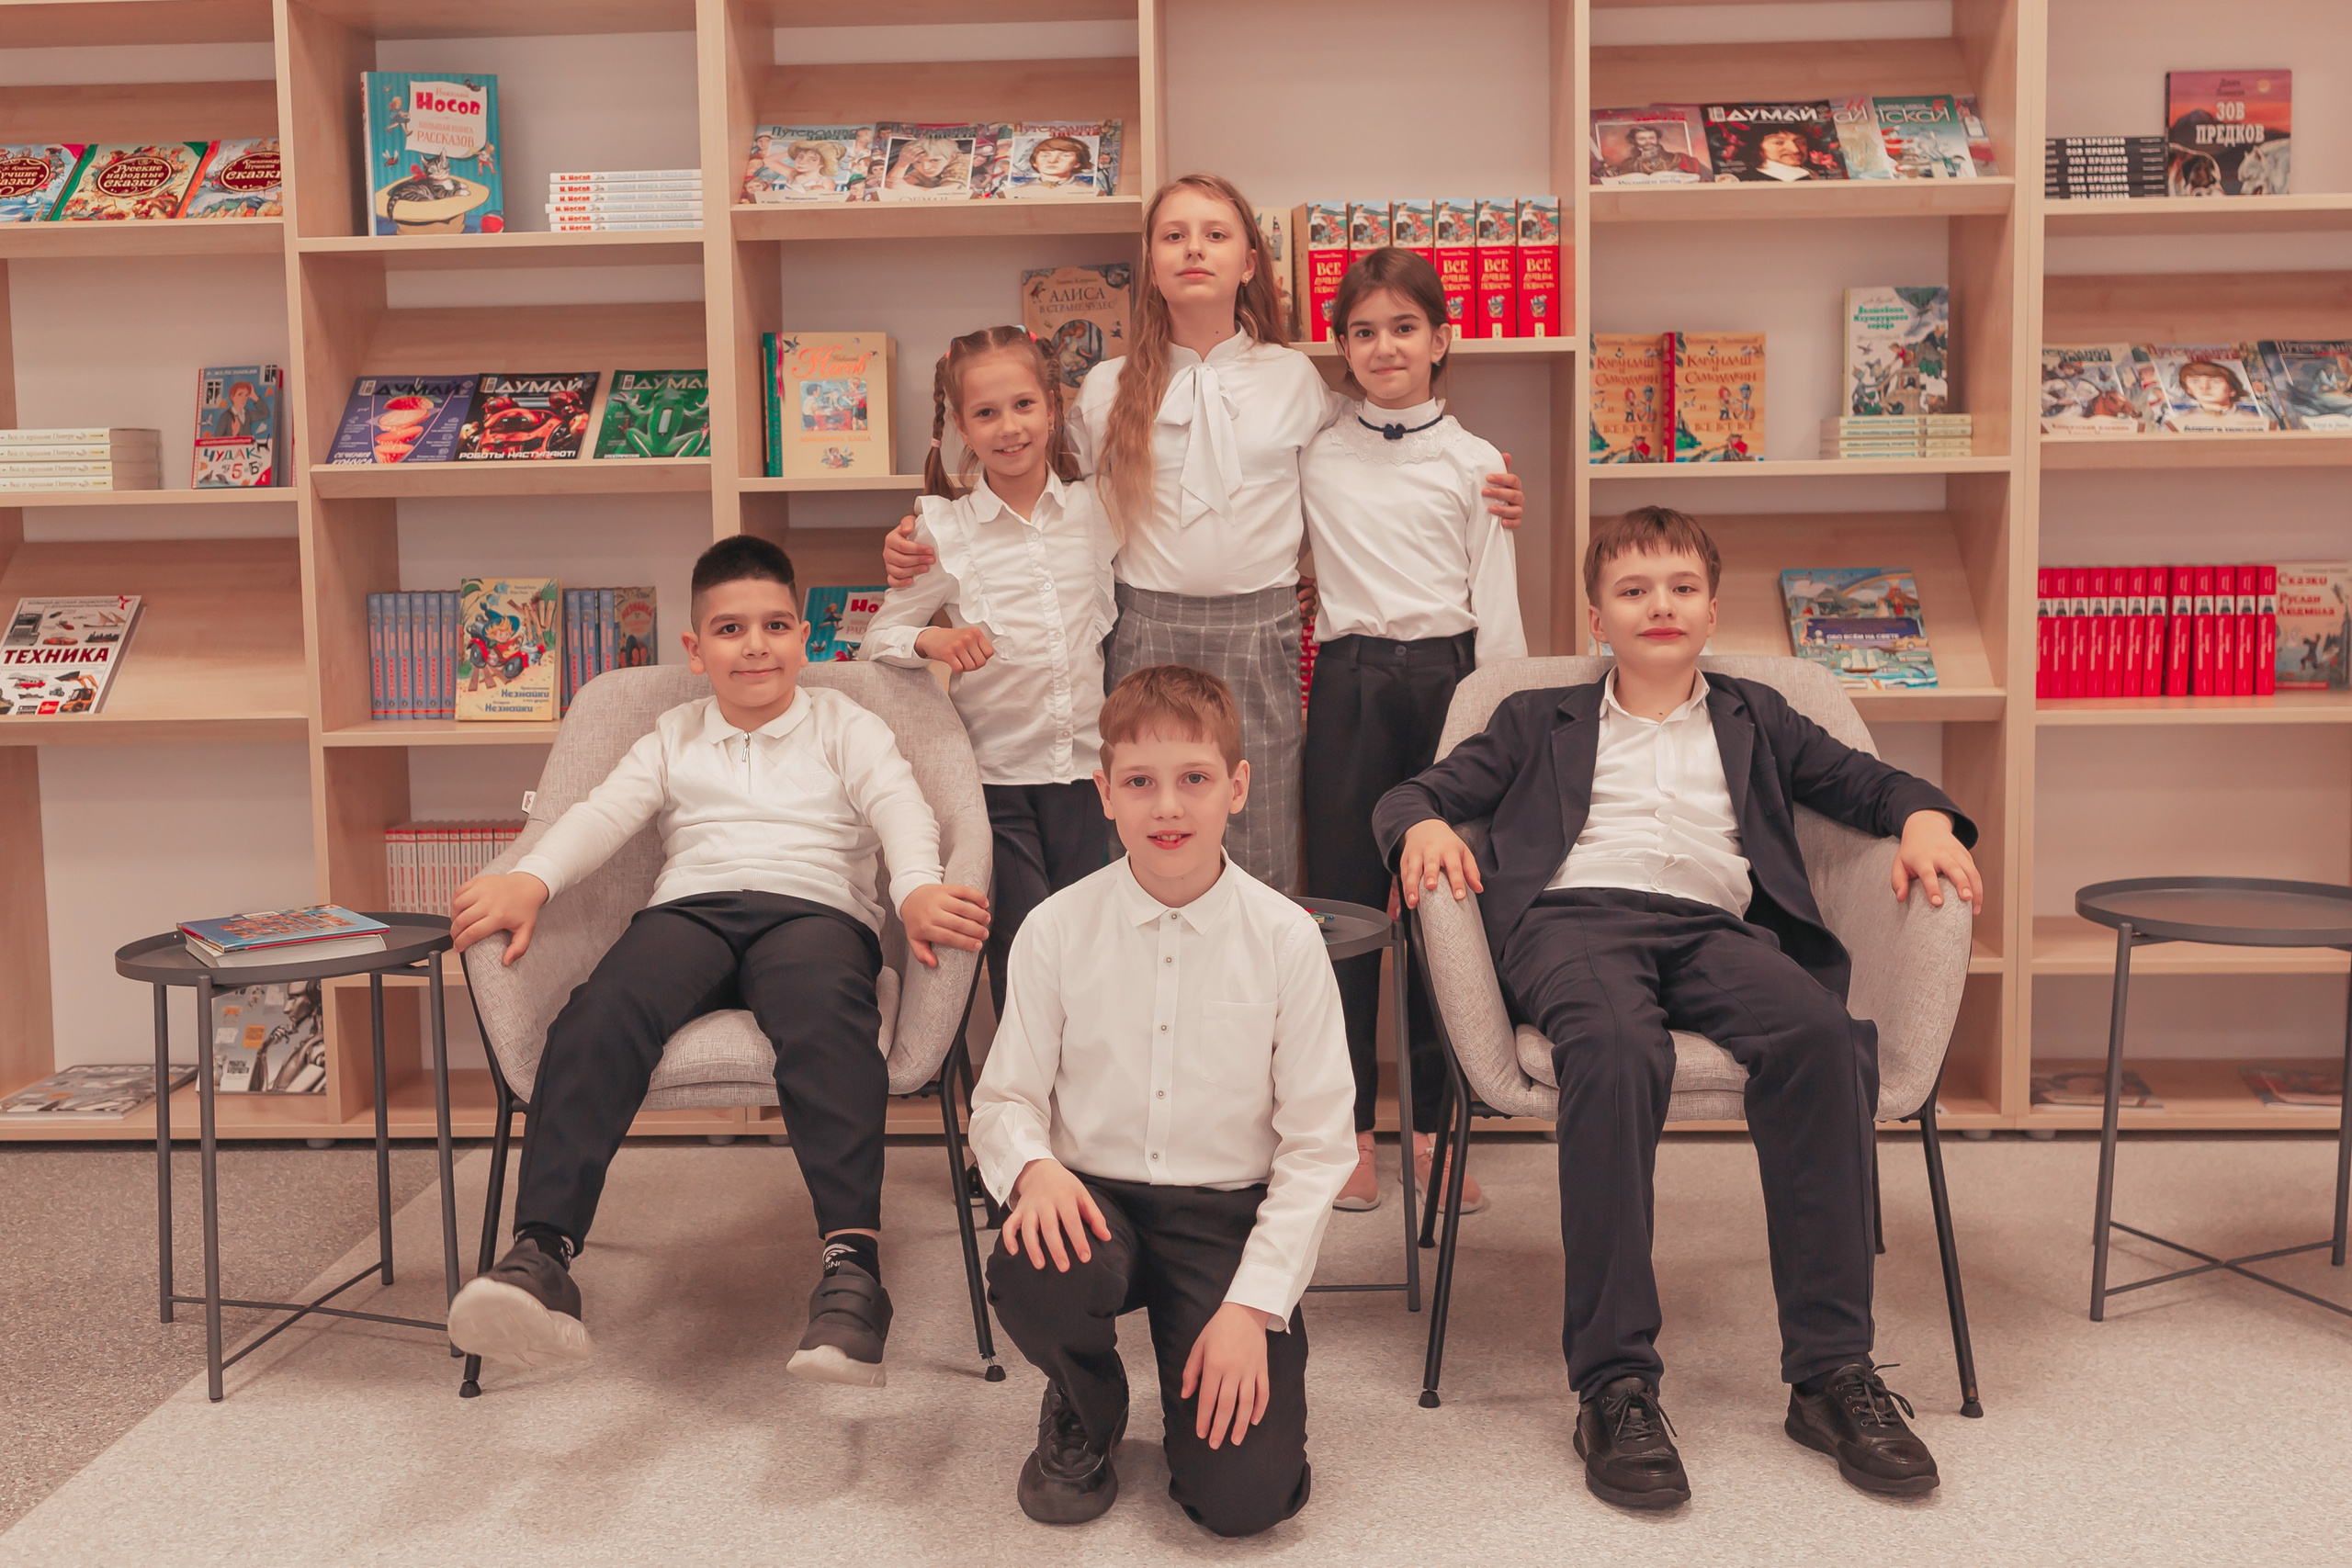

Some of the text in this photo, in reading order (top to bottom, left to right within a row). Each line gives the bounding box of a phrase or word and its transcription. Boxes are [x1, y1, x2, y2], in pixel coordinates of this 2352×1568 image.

[416, 92, 480, 115] Носов
[1726, 106, 1817, 121] ДУМАЙ
[2216, 101, 2245, 121] ЗОВ
[417, 131, 474, 147] РАССКАЗОВ
[2195, 124, 2265, 147] ПРЕДКОВ
[114, 165, 163, 173] Русские
[1316, 262, 1341, 275] ВСЕ
[1443, 259, 1468, 273] ВСЕ
[1484, 258, 1509, 272] ВСЕ
[1526, 258, 1551, 272] ВСЕ
[1049, 288, 1105, 302] АЛИСА
[1046, 303, 1082, 312] СТРАНЕ
[1086, 300, 1114, 310] ЧУДЕС
[791, 344, 872, 378] Носов
[373, 381, 462, 395] ДУМАЙ
[495, 378, 583, 393] ДУМАЙ
[204, 447, 262, 462] ЧУДАК
[232, 463, 243, 479] 5
[4, 648, 109, 664] ТЕХНИКА
[501, 689, 549, 697] Незнайки
[485, 703, 533, 712] Незнайки
